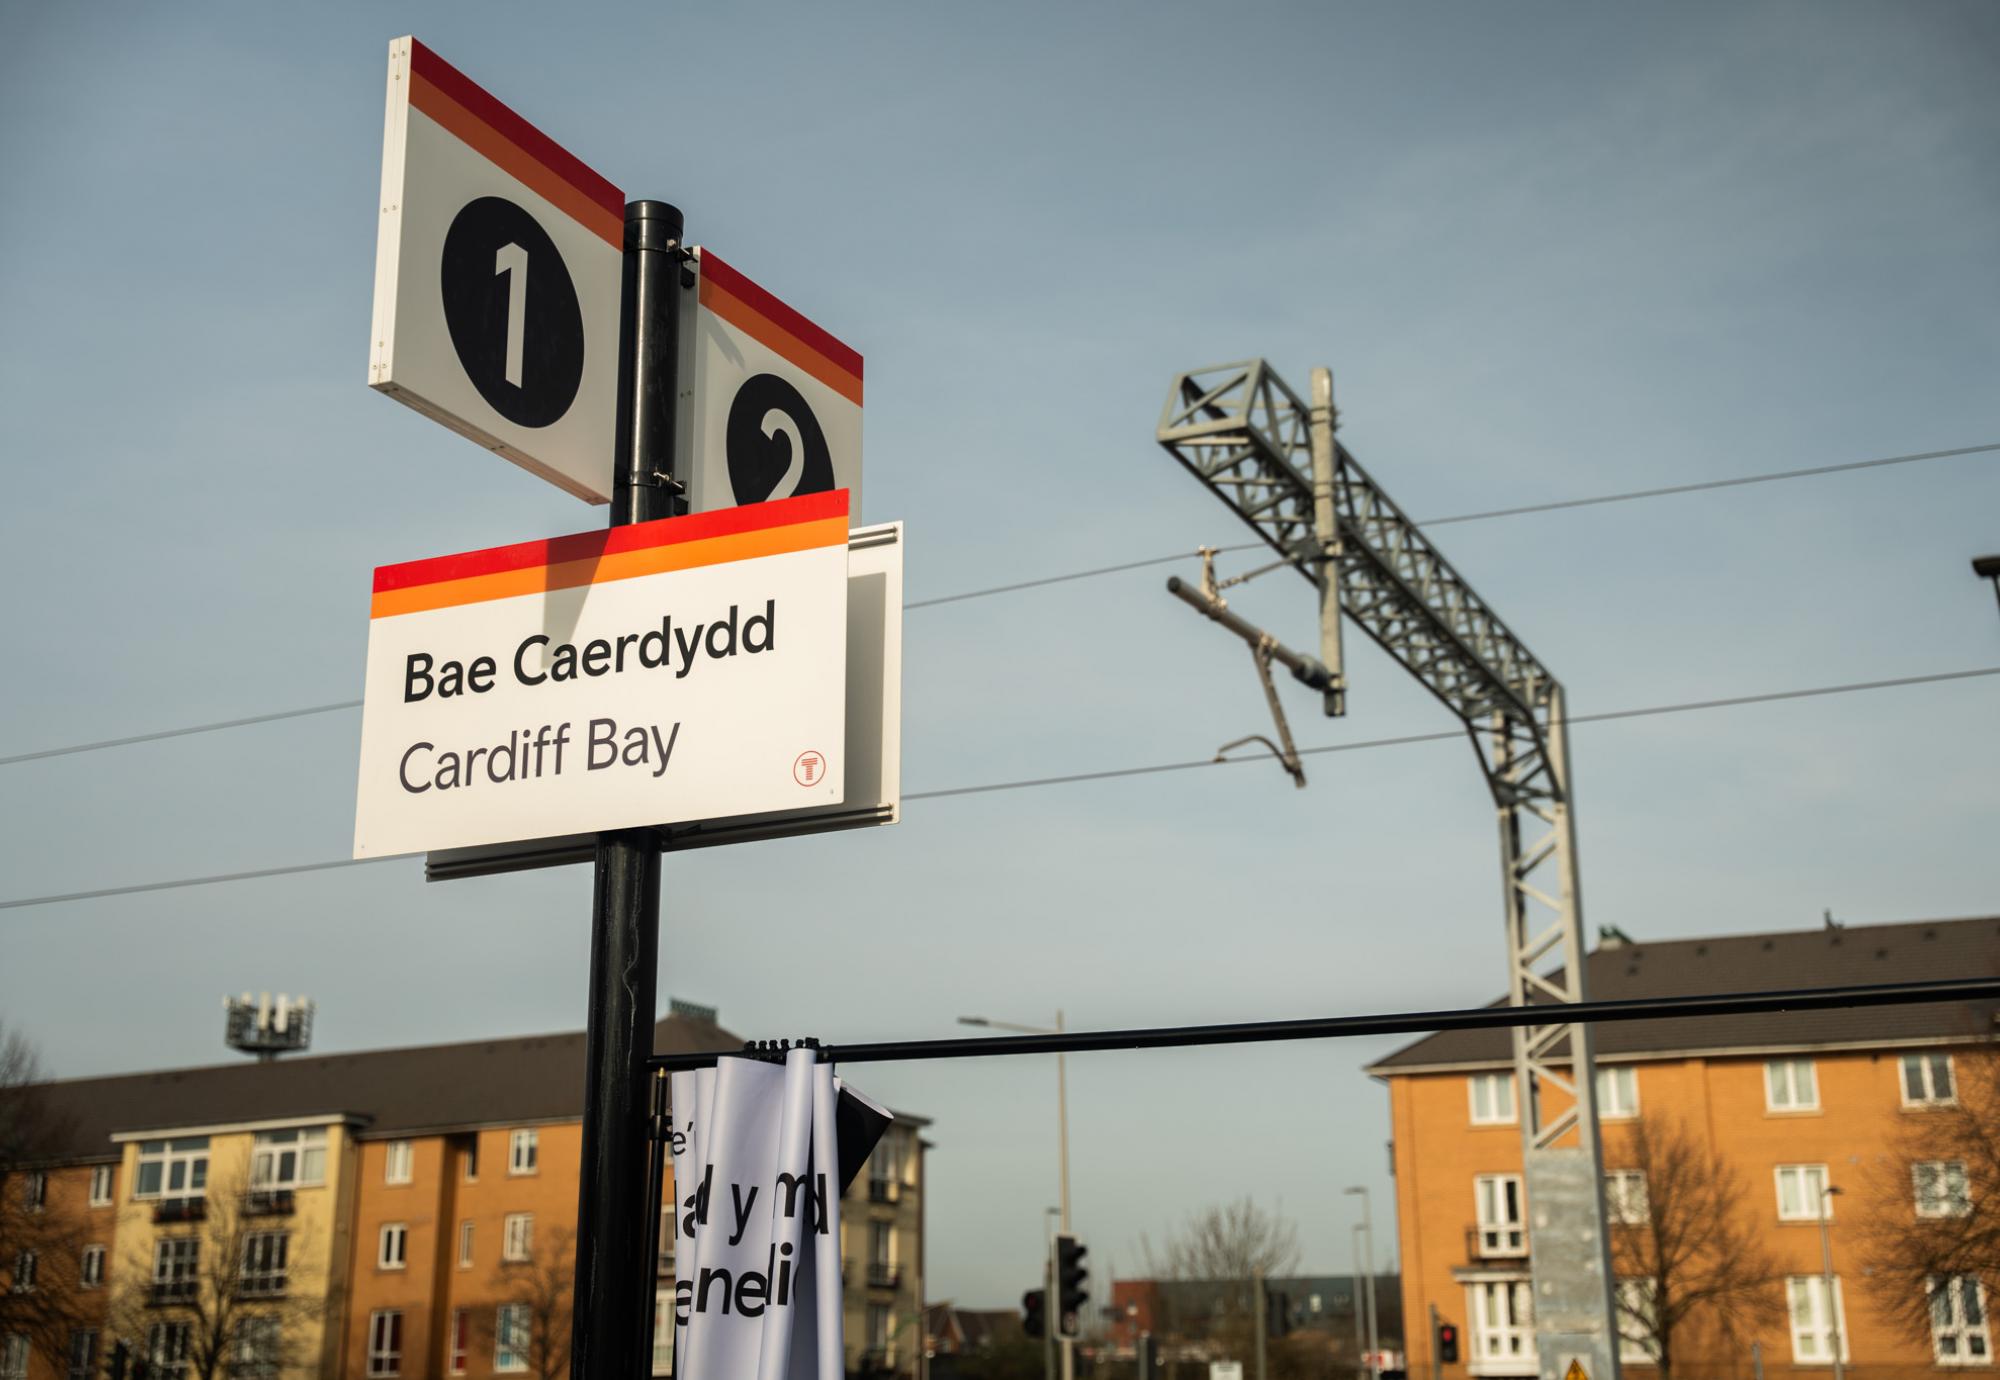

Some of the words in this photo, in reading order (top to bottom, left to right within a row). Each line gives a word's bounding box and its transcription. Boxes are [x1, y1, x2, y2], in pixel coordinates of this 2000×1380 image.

[495, 241, 529, 389] 1
[760, 407, 805, 503] 2
[404, 652, 497, 704] Bae
[513, 599, 775, 686] Caerdydd
[400, 722, 571, 794] Cardiff
[586, 718, 681, 778] Bay
[728, 1183, 760, 1247] y
